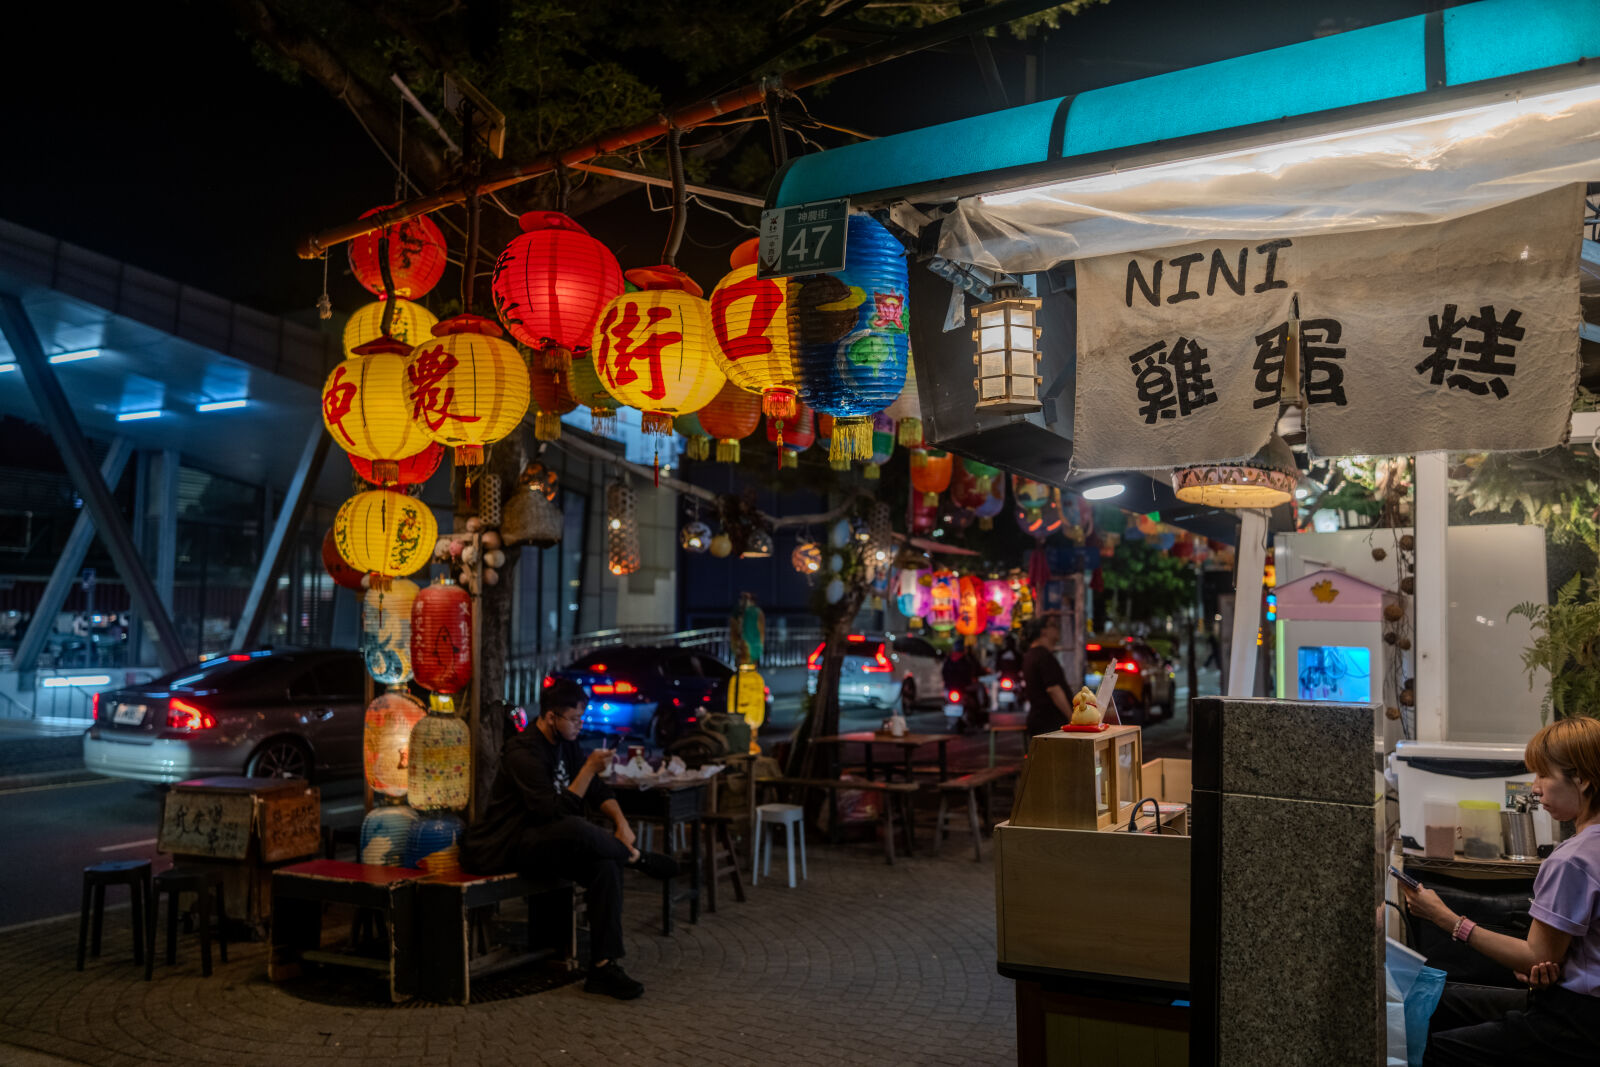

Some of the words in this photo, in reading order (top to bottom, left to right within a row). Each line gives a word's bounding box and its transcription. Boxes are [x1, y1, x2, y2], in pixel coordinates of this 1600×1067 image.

[787, 225, 832, 261] 47
[1125, 238, 1293, 308] NINI
[407, 344, 481, 432] 農
[598, 301, 682, 400] 街
[1127, 303, 1526, 425] 雞蛋糕
